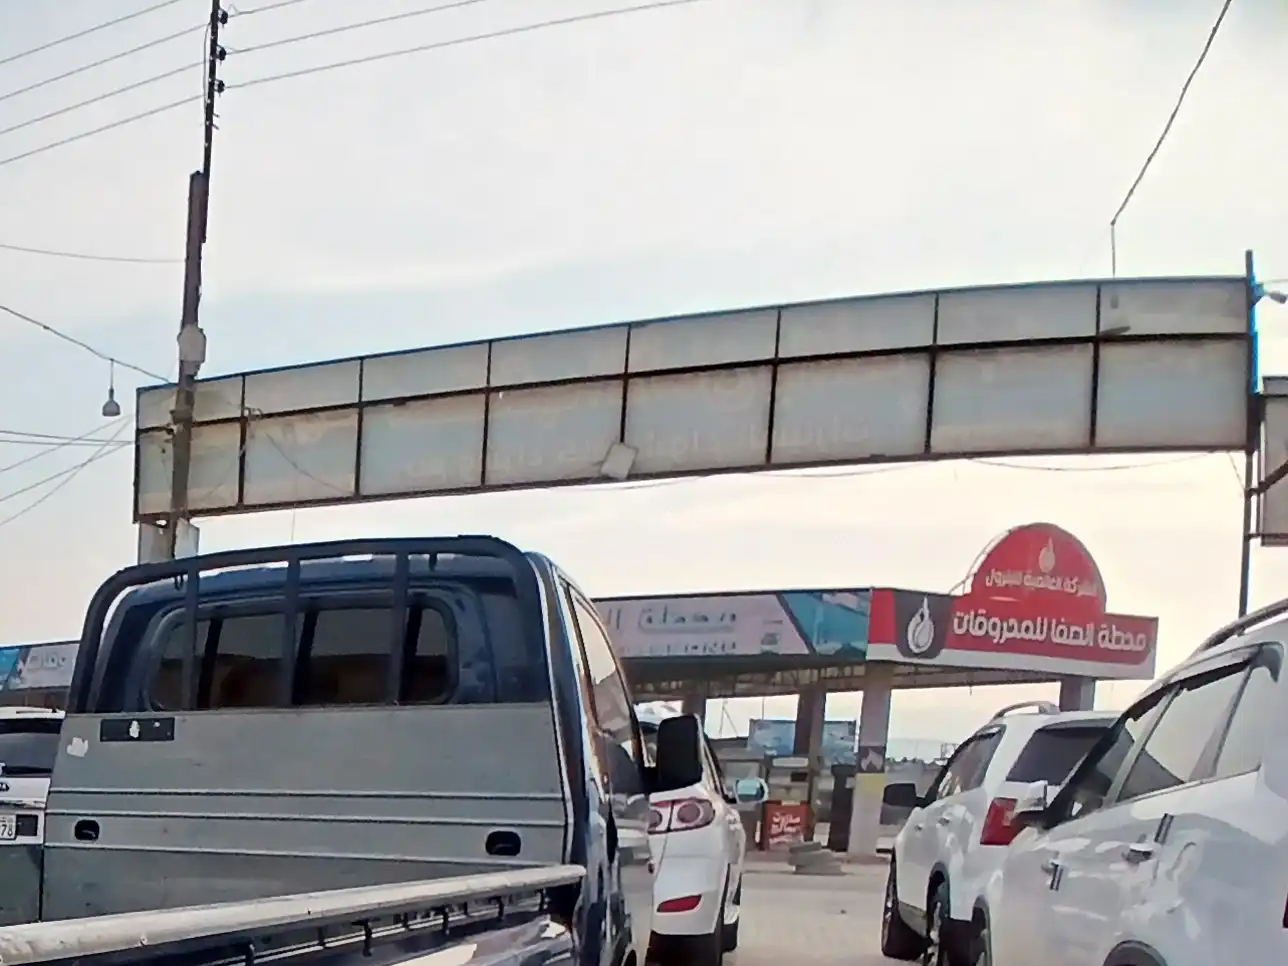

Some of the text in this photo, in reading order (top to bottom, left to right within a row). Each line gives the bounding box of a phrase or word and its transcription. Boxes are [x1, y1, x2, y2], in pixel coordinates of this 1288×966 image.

[953, 609, 1147, 651] محطة الصفا للمحروقات
